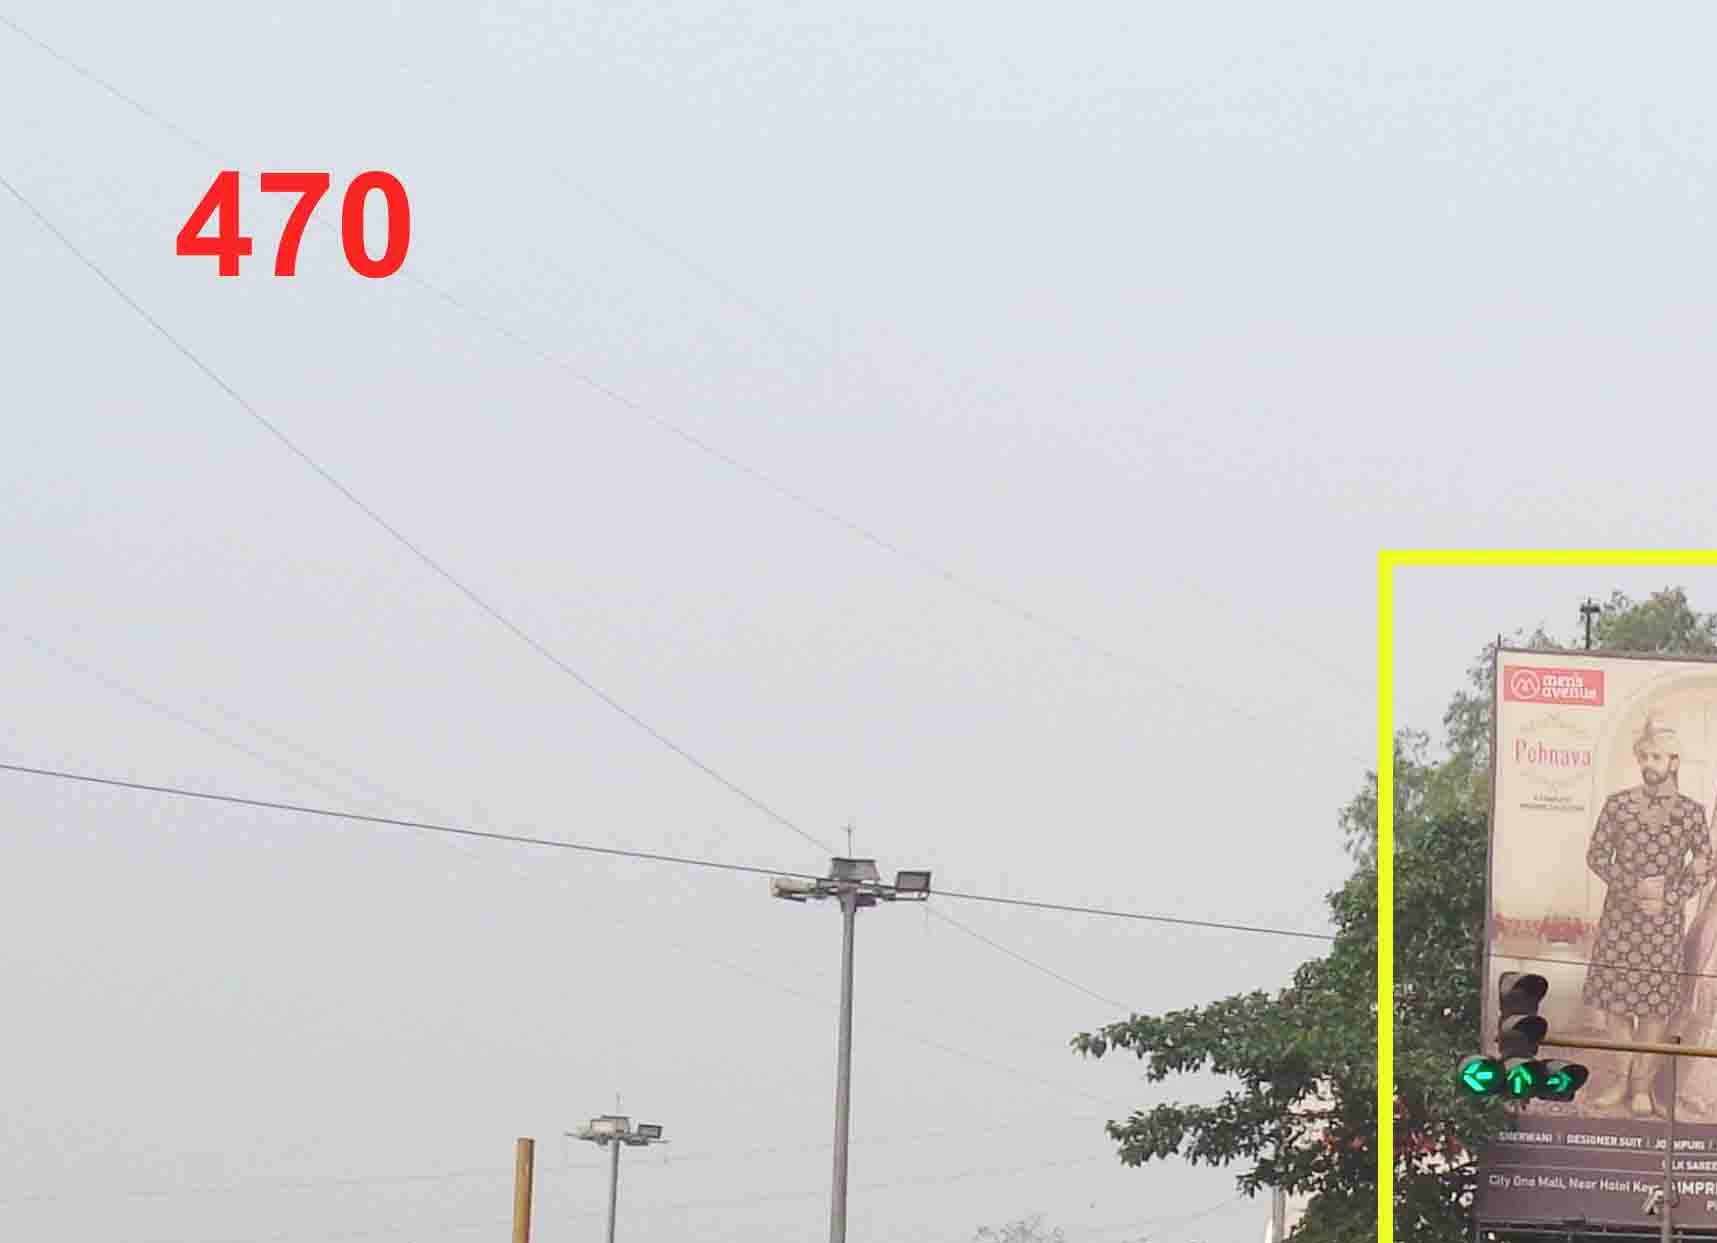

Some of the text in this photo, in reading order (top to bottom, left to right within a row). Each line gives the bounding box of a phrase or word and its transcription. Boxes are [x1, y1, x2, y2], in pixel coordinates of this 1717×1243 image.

[1619, 1136, 1642, 1149] SUIT
[1655, 1138, 1705, 1151] JOHPURI
[1488, 1174, 1512, 1188] City
[1568, 1178, 1597, 1190] Near
